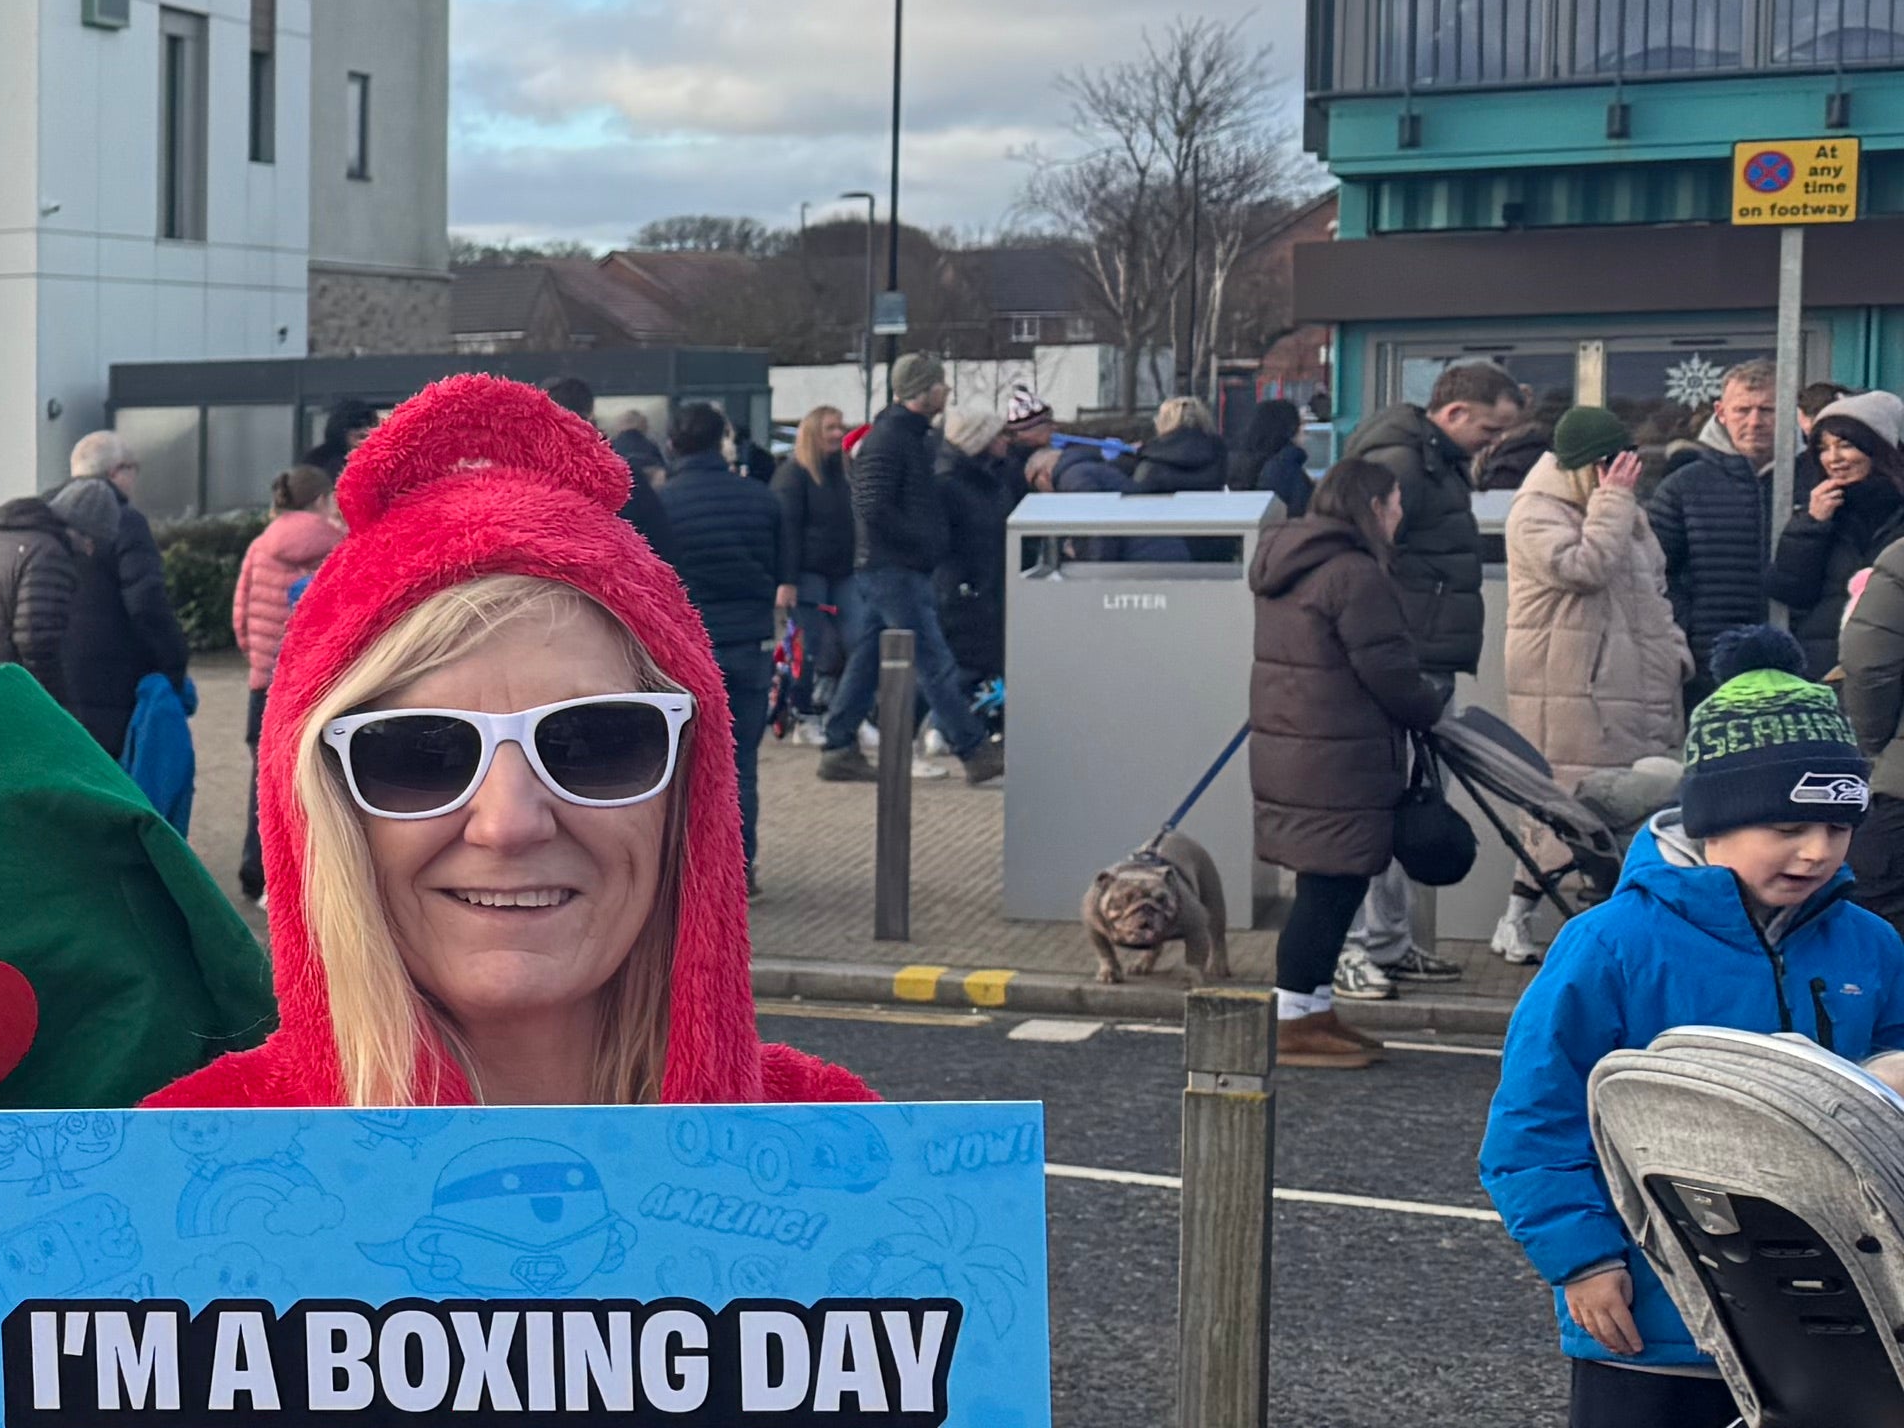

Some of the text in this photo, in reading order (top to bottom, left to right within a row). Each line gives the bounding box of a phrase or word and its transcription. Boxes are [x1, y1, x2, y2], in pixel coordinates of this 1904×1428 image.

[1815, 144, 1838, 159] At
[1808, 165, 1843, 178] any
[1803, 180, 1847, 194] time
[1738, 202, 1849, 217] on footway
[1103, 593, 1167, 610] LITTER
[924, 1123, 1038, 1176] WOW!
[638, 1182, 830, 1251] AMAZING!
[30, 1309, 950, 1414] I'M A BOXING DAY
